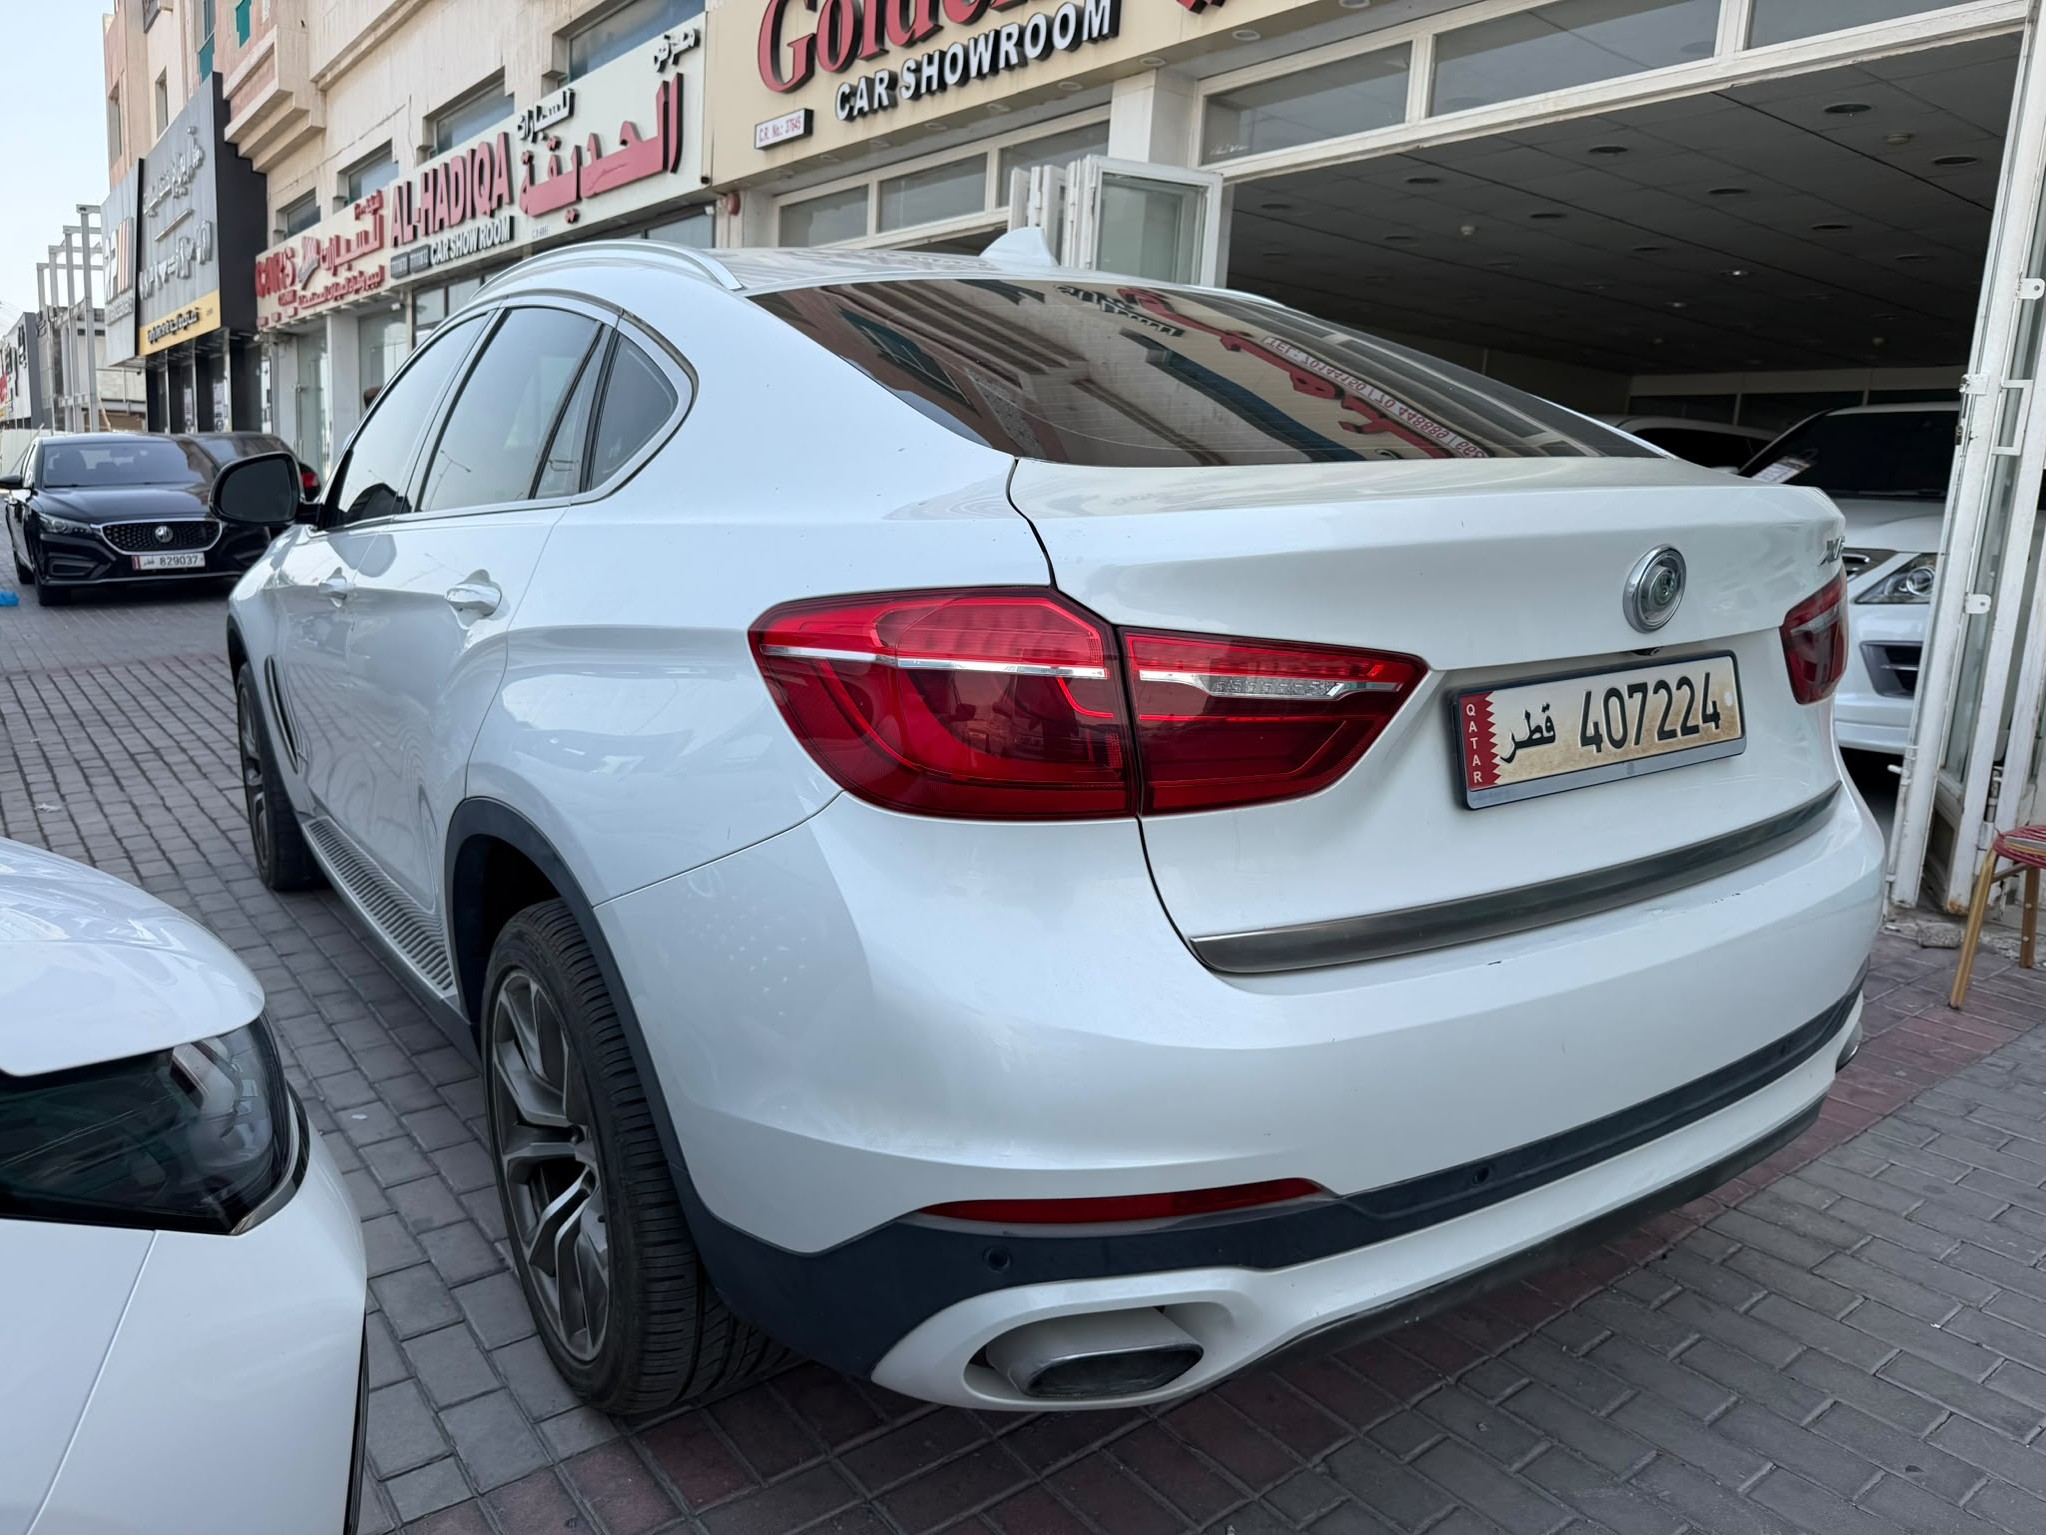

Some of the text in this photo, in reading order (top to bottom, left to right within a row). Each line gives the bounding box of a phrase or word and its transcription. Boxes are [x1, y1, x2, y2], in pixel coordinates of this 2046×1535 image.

[758, 0, 1030, 93] Gol
[835, 0, 1117, 121] CAR SHOWROOM
[391, 132, 513, 248] AL-HADIQA
[519, 73, 683, 223] الحديقة
[159, 553, 199, 567] 829037
[1465, 703, 1483, 784] QATAR
[1500, 702, 1556, 764] قطر
[1579, 671, 1721, 754] 407224
